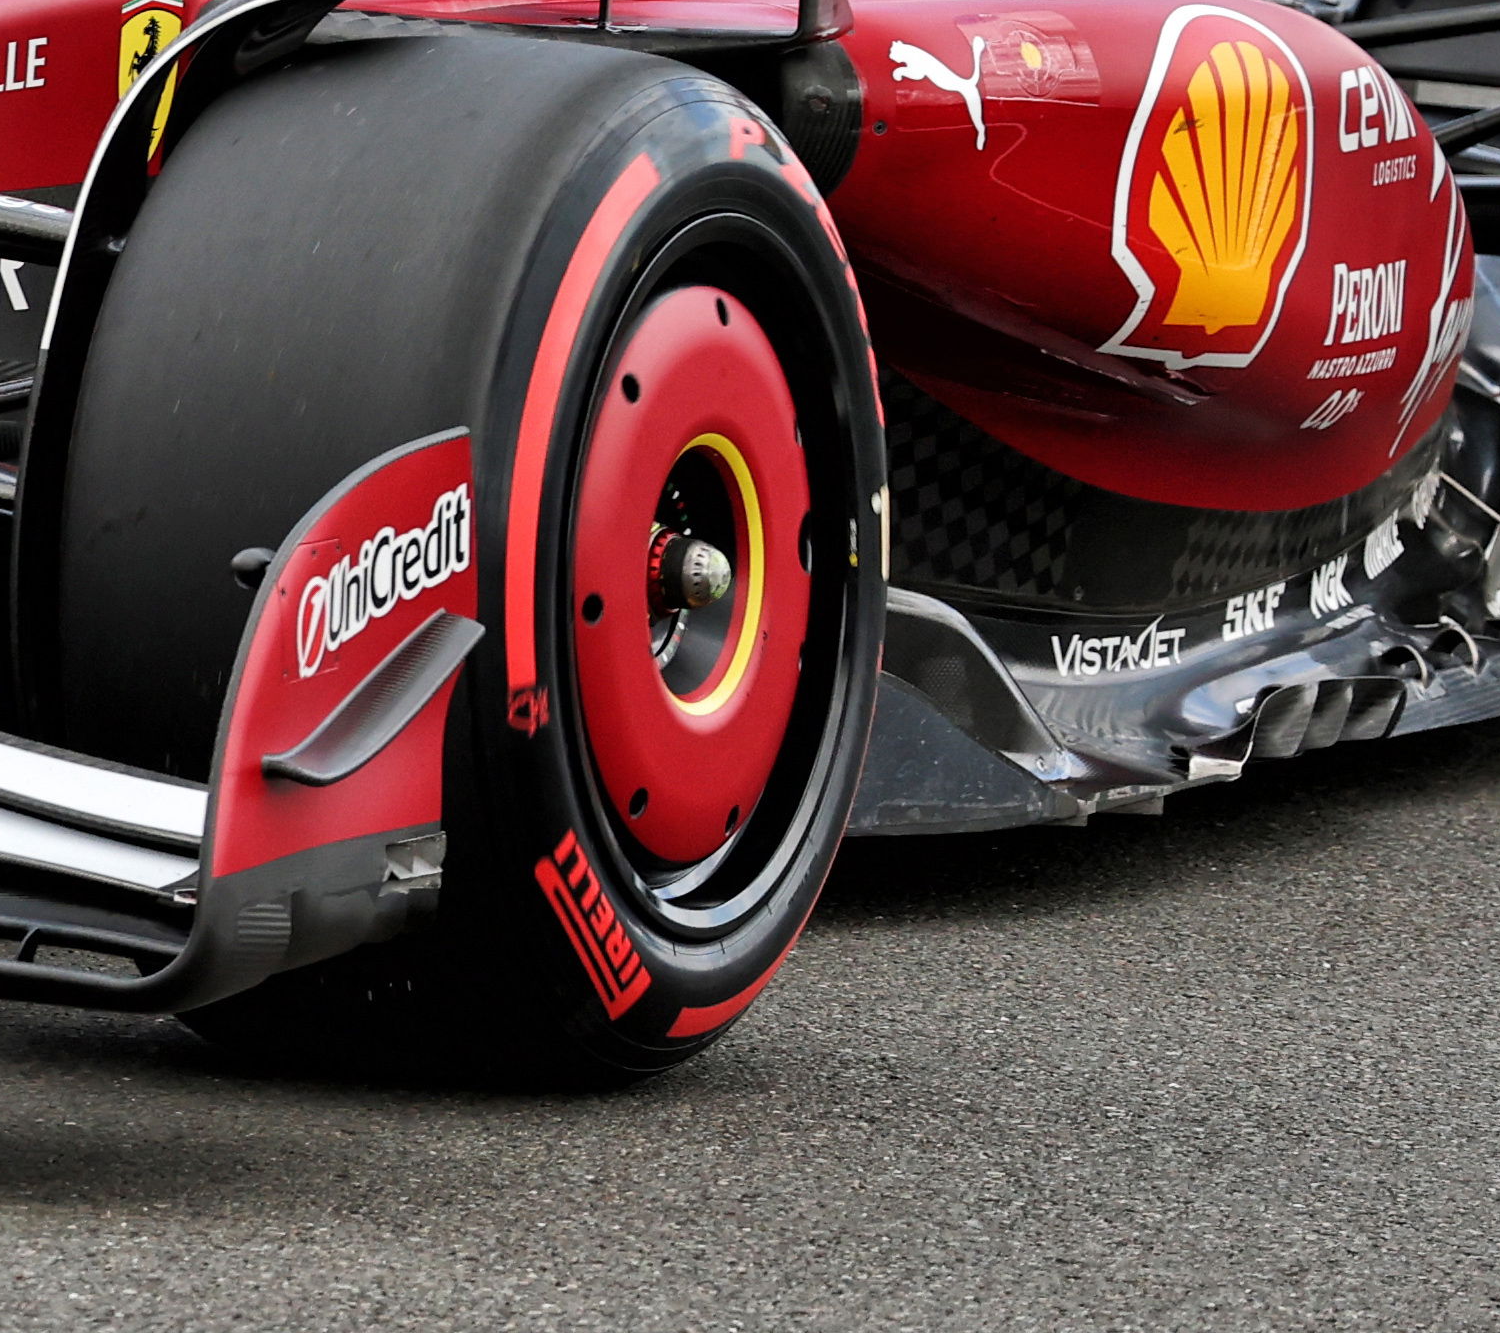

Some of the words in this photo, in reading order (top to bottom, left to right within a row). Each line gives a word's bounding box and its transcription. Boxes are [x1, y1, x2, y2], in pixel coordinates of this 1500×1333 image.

[1372, 153, 1417, 187] LOGISTICS
[1323, 259, 1407, 347] PERONI
[1306, 355, 1356, 380] NASTRO
[1355, 346, 1397, 376] AZZURRO
[328, 492, 467, 643] UniCredit
[1310, 551, 1354, 620] NGK
[1221, 581, 1287, 642] SKF
[534, 827, 653, 1023] PIRELLI
